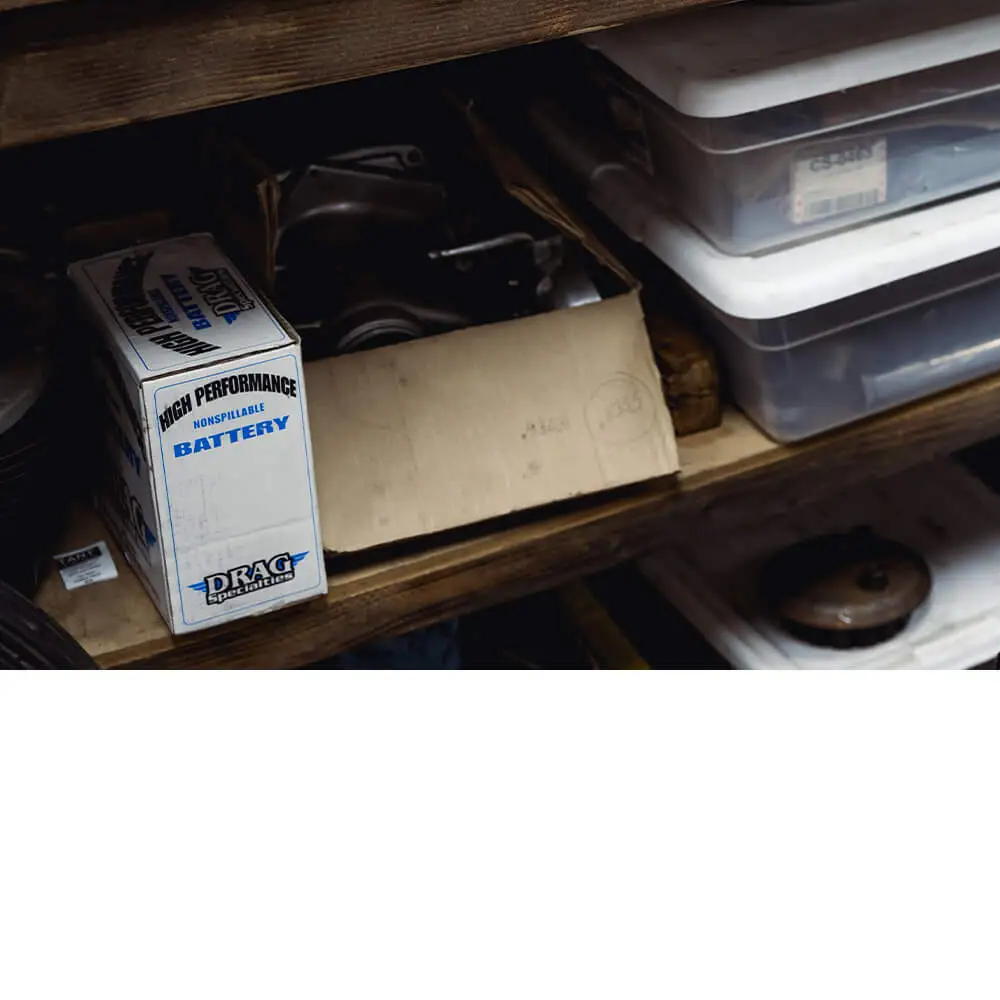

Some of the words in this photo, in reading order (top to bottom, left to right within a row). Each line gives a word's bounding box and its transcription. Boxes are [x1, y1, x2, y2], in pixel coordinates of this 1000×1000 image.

[158, 392, 194, 434] HIGH
[194, 373, 298, 408] PERFORMANCE
[192, 402, 266, 431] NONSPILLABLE
[173, 414, 291, 459] BATTERY
[206, 554, 293, 593] DRAG
[207, 570, 295, 605] Specialties
